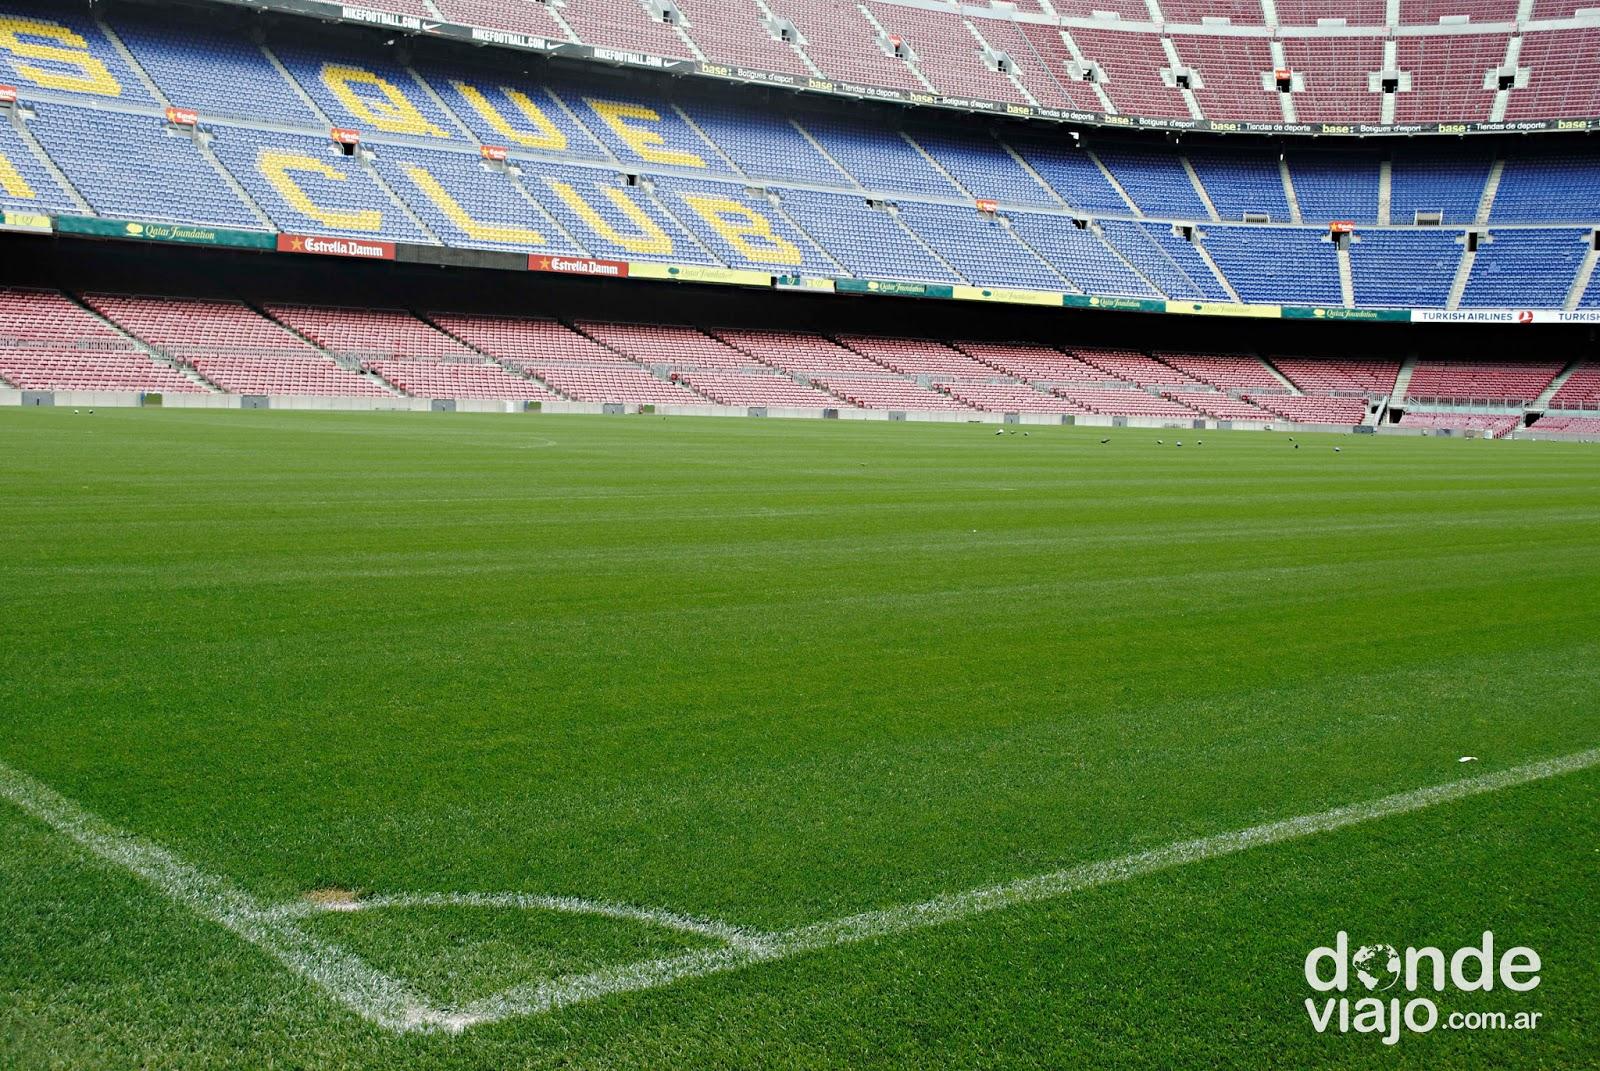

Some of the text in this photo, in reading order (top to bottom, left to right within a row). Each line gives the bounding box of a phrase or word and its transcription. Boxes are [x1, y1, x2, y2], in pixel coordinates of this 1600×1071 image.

[342, 7, 420, 30] NIKEFOOTBALL.COM
[472, 28, 545, 50] NIKEFOOTBALL.COM
[594, 47, 662, 67] NIKEFOOTBALL.COM
[319, 62, 706, 168] QUE
[256, 148, 802, 266] CLUB
[145, 225, 215, 240] Qatar Foundation
[304, 238, 383, 257] Estrella Damm
[551, 257, 618, 275] Estrella Damm
[1422, 312, 1513, 321] TURKISH AIRLINES
